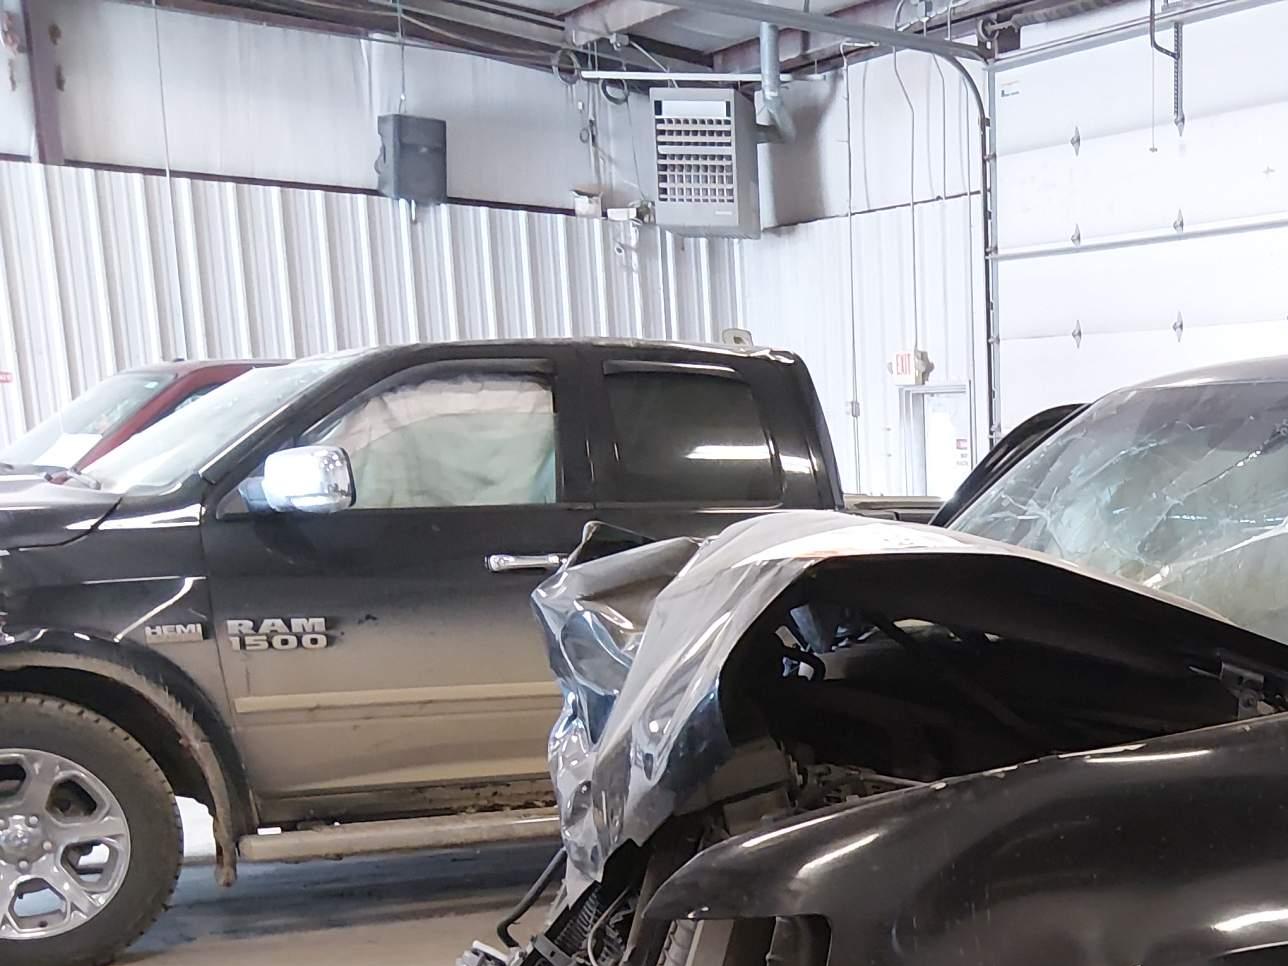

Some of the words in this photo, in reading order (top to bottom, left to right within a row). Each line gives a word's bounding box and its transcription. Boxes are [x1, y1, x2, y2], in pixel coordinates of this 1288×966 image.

[895, 353, 911, 375] EXIT
[145, 623, 203, 636] HEMI
[226, 617, 326, 634] RAM
[229, 634, 328, 650] 1500
